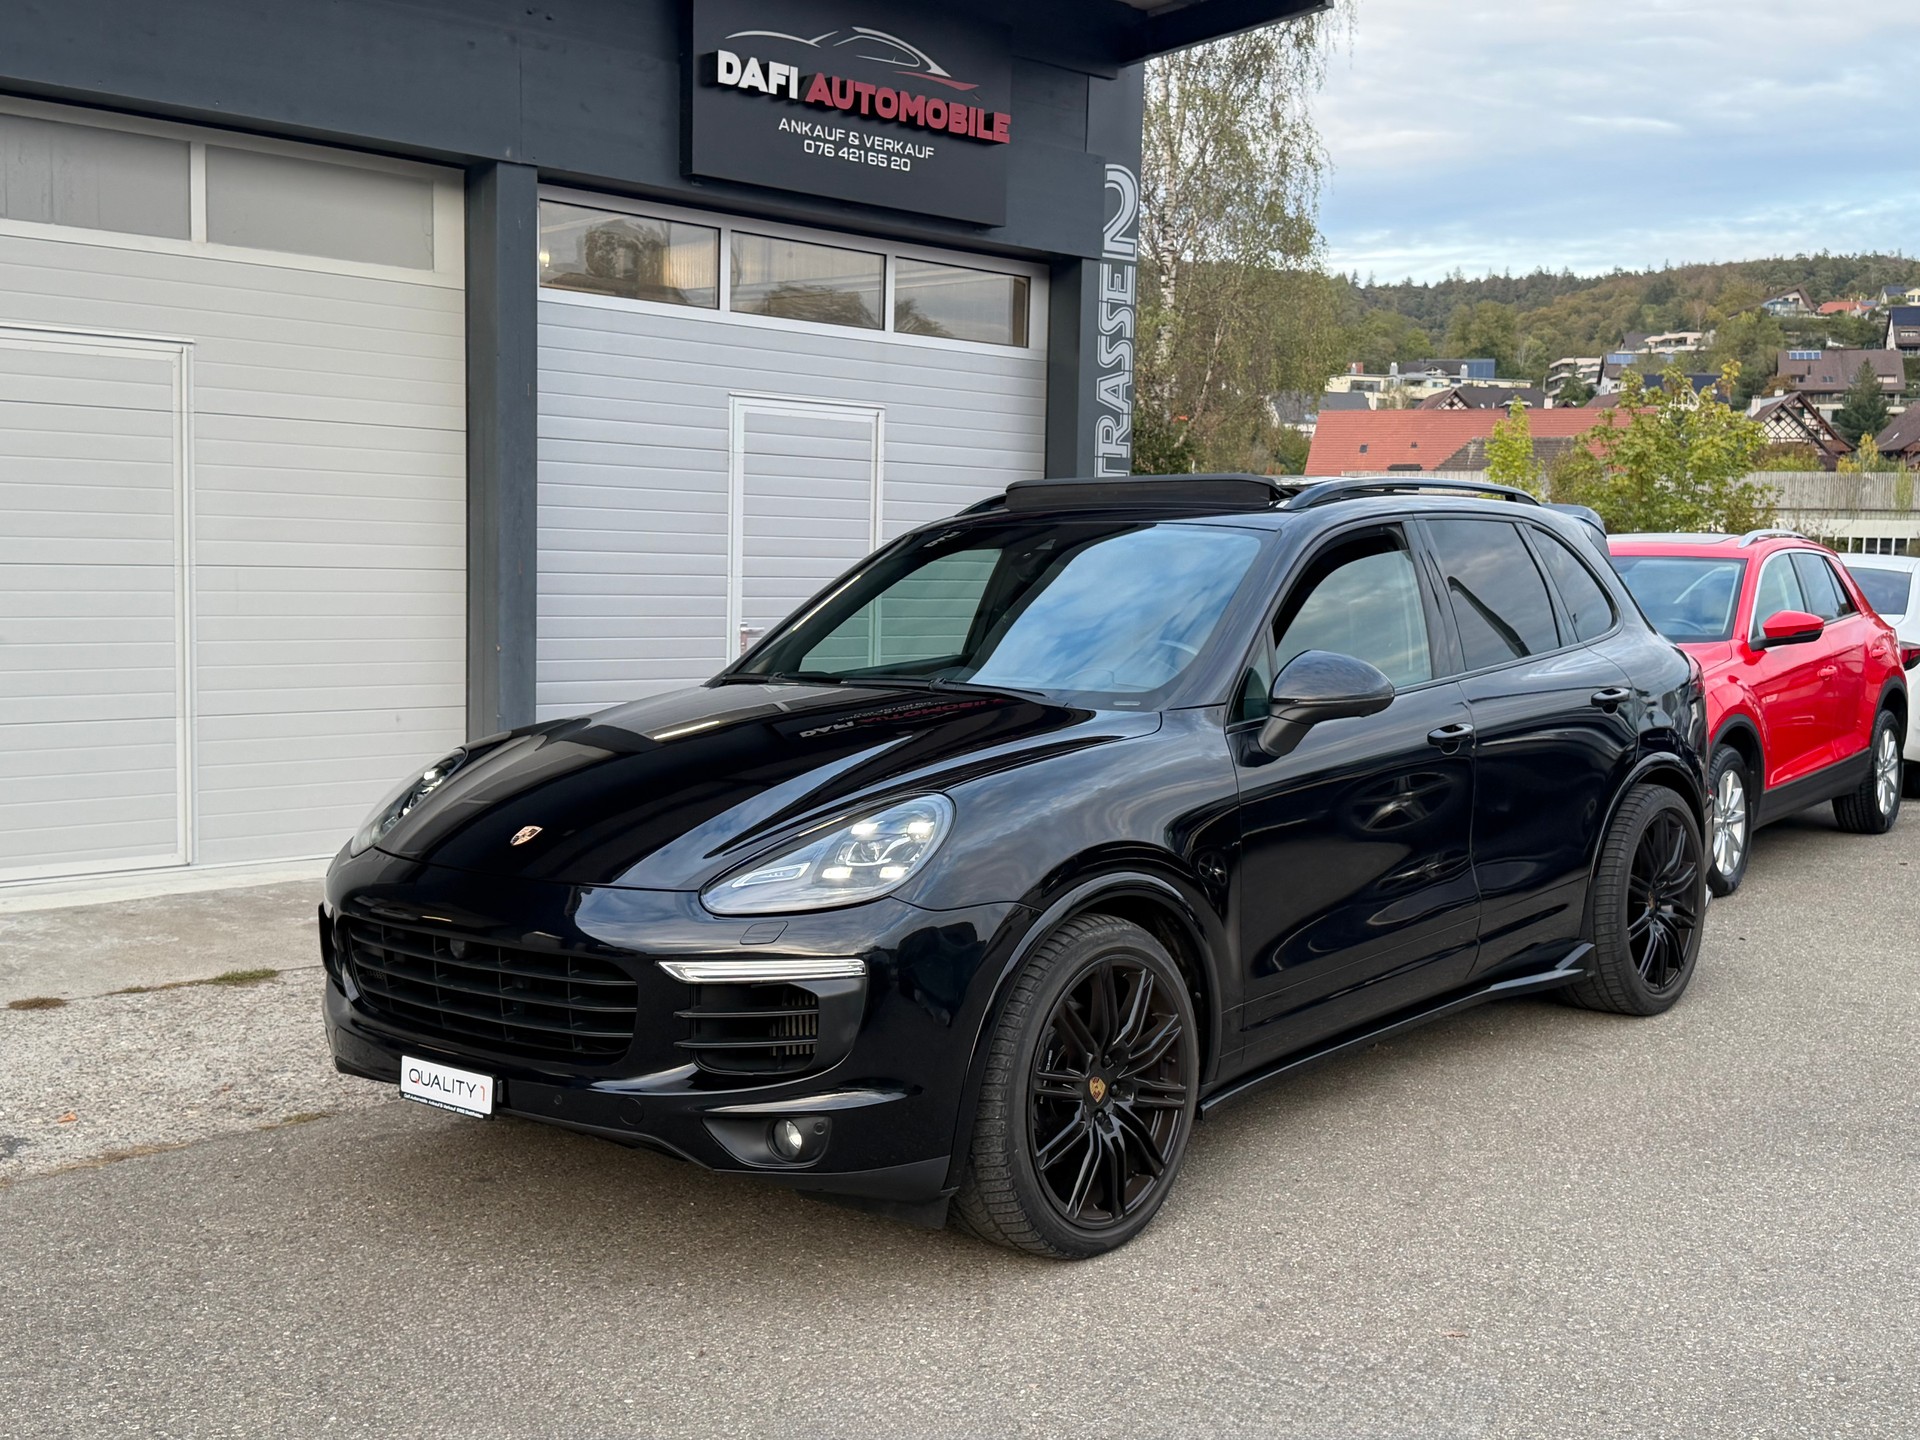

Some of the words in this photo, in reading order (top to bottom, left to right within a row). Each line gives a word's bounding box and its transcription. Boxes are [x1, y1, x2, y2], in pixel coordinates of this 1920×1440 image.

[717, 49, 799, 100] DAFI
[804, 72, 1011, 144] AUTOMOBILE
[778, 117, 846, 142] ANKAUF
[848, 131, 860, 145] &
[863, 133, 935, 159] VERKAUF
[803, 139, 835, 157] 076
[838, 146, 865, 163] 421
[867, 152, 888, 167] 65
[890, 156, 911, 172] 20
[1102, 163, 1139, 262] 2
[408, 1068, 477, 1099] QUALITY
